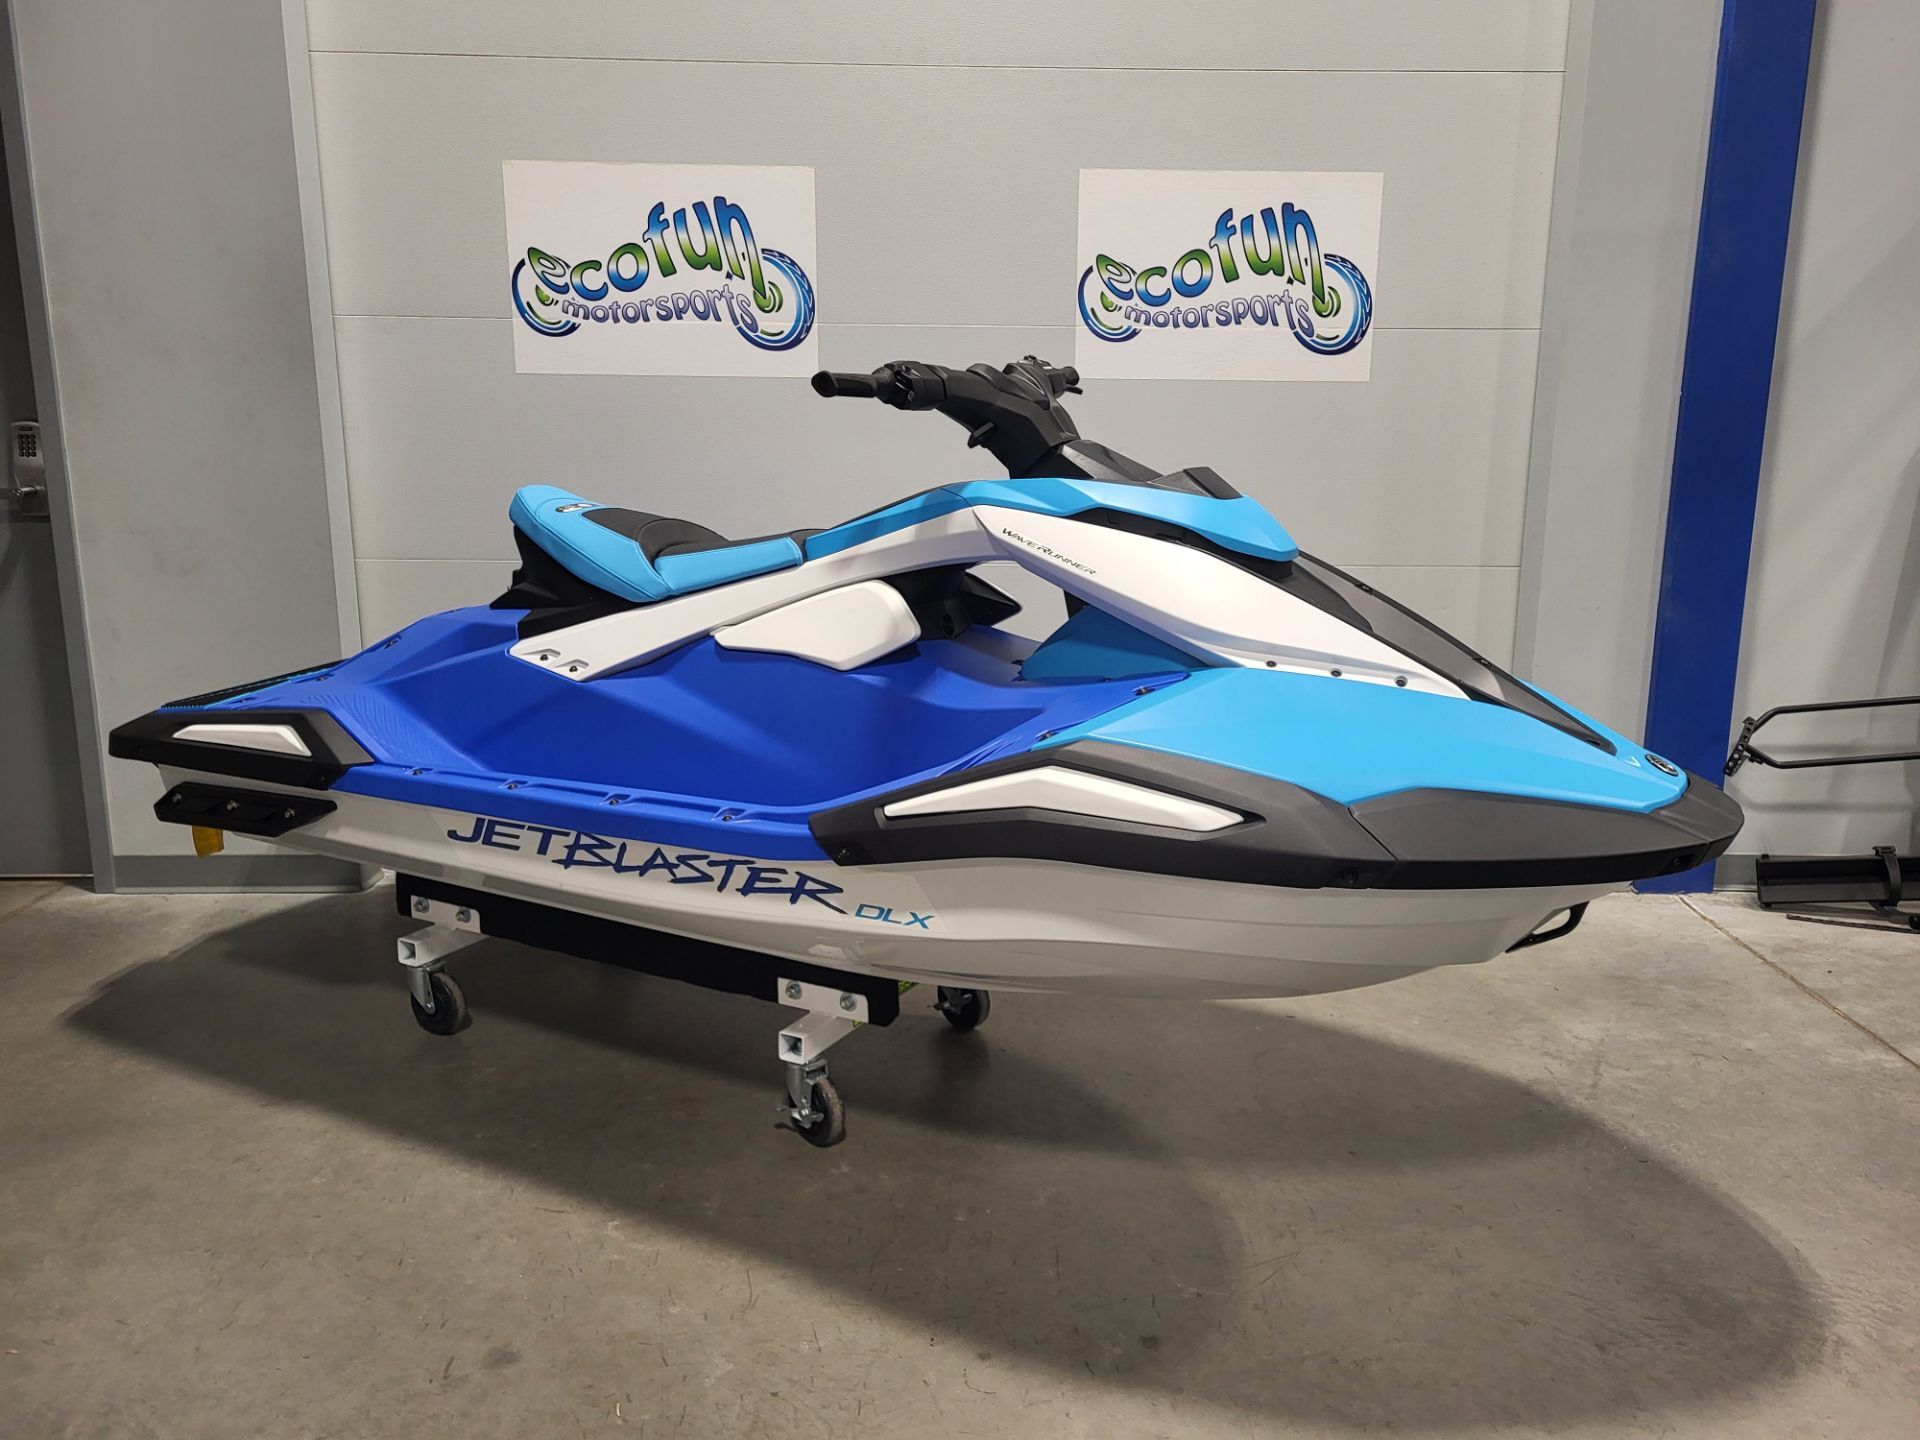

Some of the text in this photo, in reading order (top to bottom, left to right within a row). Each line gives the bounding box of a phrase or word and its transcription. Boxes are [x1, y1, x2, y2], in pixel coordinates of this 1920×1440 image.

[561, 284, 760, 334] motorsports
[1125, 289, 1315, 338] motorsports
[854, 903, 935, 930] DLX
